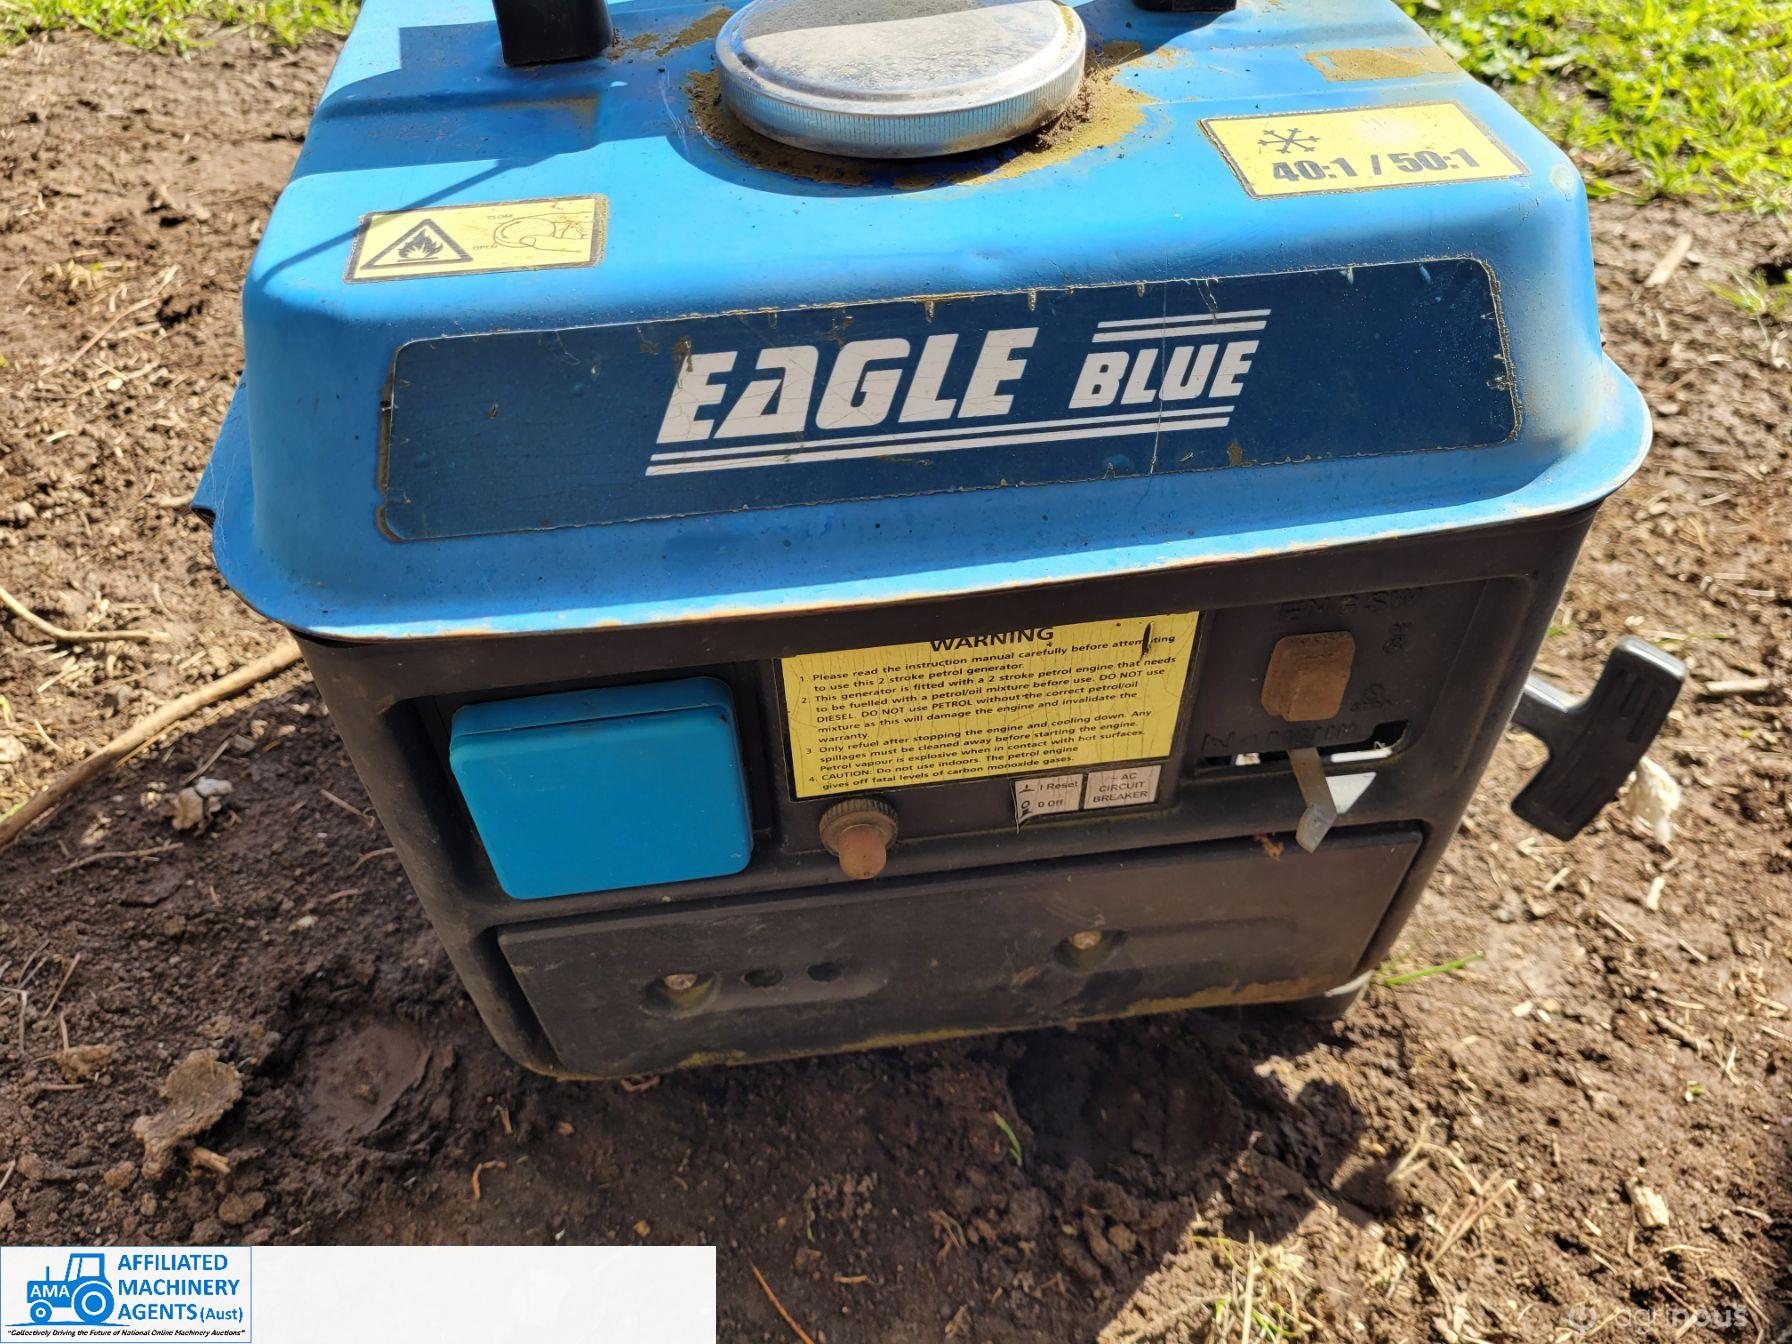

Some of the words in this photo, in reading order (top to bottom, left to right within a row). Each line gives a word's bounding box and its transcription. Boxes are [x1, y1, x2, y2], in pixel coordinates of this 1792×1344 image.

[1271, 156, 1358, 182] 40:1
[1370, 155, 1382, 175] /
[1391, 147, 1480, 174] 50:1
[655, 327, 1040, 445] EAGLE
[1068, 339, 1260, 410] BLUE
[930, 627, 1054, 652] WARNING
[813, 673, 849, 682] Please
[853, 668, 877, 676] read
[906, 658, 967, 670] instruction
[972, 653, 1014, 663] manual
[1019, 648, 1068, 658] carefully
[1072, 643, 1108, 652] before
[1112, 635, 1175, 648] attemting
[830, 682, 849, 690] use
[854, 678, 874, 687] this
[889, 673, 925, 683] stroke
[929, 668, 962, 679] petrol
[967, 662, 1024, 675] generator.
[832, 703, 845, 711] be
[850, 698, 887, 708] fuelled
[892, 695, 917, 704] with
[932, 687, 982, 701] petrol/oil
[987, 682, 1029, 693] mixture
[1033, 678, 1069, 688] before
[1074, 676, 1094, 684] use.
[1099, 673, 1116, 681] DO
[1120, 670, 1143, 678] NOT
[842, 687, 896, 701] generator
[914, 680, 944, 690] fitted
[948, 679, 974, 687] with
[1000, 671, 1034, 680] stroke
[1038, 668, 1071, 678] petrol
[1076, 665, 1113, 676] engine
[1117, 661, 1140, 669] that
[1144, 657, 1176, 666] needs
[817, 713, 856, 723] DIESEL.
[883, 707, 904, 715] NOT
[932, 699, 973, 709] PETROL
[977, 693, 1024, 704] without
[1025, 691, 1042, 699] the
[1047, 688, 1084, 697] correct
[1089, 681, 1137, 693] petrol/oil
[818, 724, 860, 733] mixture
[880, 716, 899, 725] this
[904, 714, 923, 722] will
[927, 709, 971, 722] damage
[997, 704, 1034, 714] engine
[1038, 699, 1058, 708] and
[1062, 694, 1115, 705] invalidate
[1120, 691, 1137, 699] the
[818, 733, 869, 744] warranty.
[819, 744, 843, 754] Only
[848, 740, 879, 749] refuel
[883, 736, 909, 746] after
[913, 731, 960, 743] stopping
[966, 728, 982, 736] the
[987, 724, 1023, 735] engine
[1027, 719, 1047, 729] and
[1052, 716, 1090, 727] cooling
[1094, 712, 1126, 721] down.
[1132, 709, 1152, 719] Any
[820, 752, 866, 763] spillages
[871, 748, 897, 756] must
[919, 740, 960, 750] cleaned
[964, 737, 991, 747] away
[995, 733, 1031, 742] before
[1034, 728, 1075, 738] starting
[1080, 724, 1097, 732] the
[1099, 721, 1137, 731] engine.
[820, 762, 851, 772] Petrol
[855, 758, 892, 769] vapour
[908, 750, 957, 763] explosive
[961, 747, 991, 756] when
[1008, 741, 1047, 751] contact
[1051, 737, 1074, 745] with
[1078, 734, 1096, 742] hot
[822, 770, 872, 780] CAUTION:
[939, 758, 981, 767] indoors.
[987, 753, 1005, 762] The
[1008, 750, 1039, 760] petrol
[1043, 746, 1078, 756] engine
[822, 781, 849, 790] gives
[853, 777, 868, 786] off
[872, 774, 895, 783] fatal
[900, 772, 928, 780] levels
[947, 766, 983, 775] carbon
[987, 760, 1040, 770] monoxide
[1043, 755, 1074, 765] gases.
[1047, 781, 1077, 789] Reset
[1099, 781, 1145, 792] CIRCUIT
[1048, 799, 1064, 807] Off
[1093, 791, 1148, 803] BREAKER
